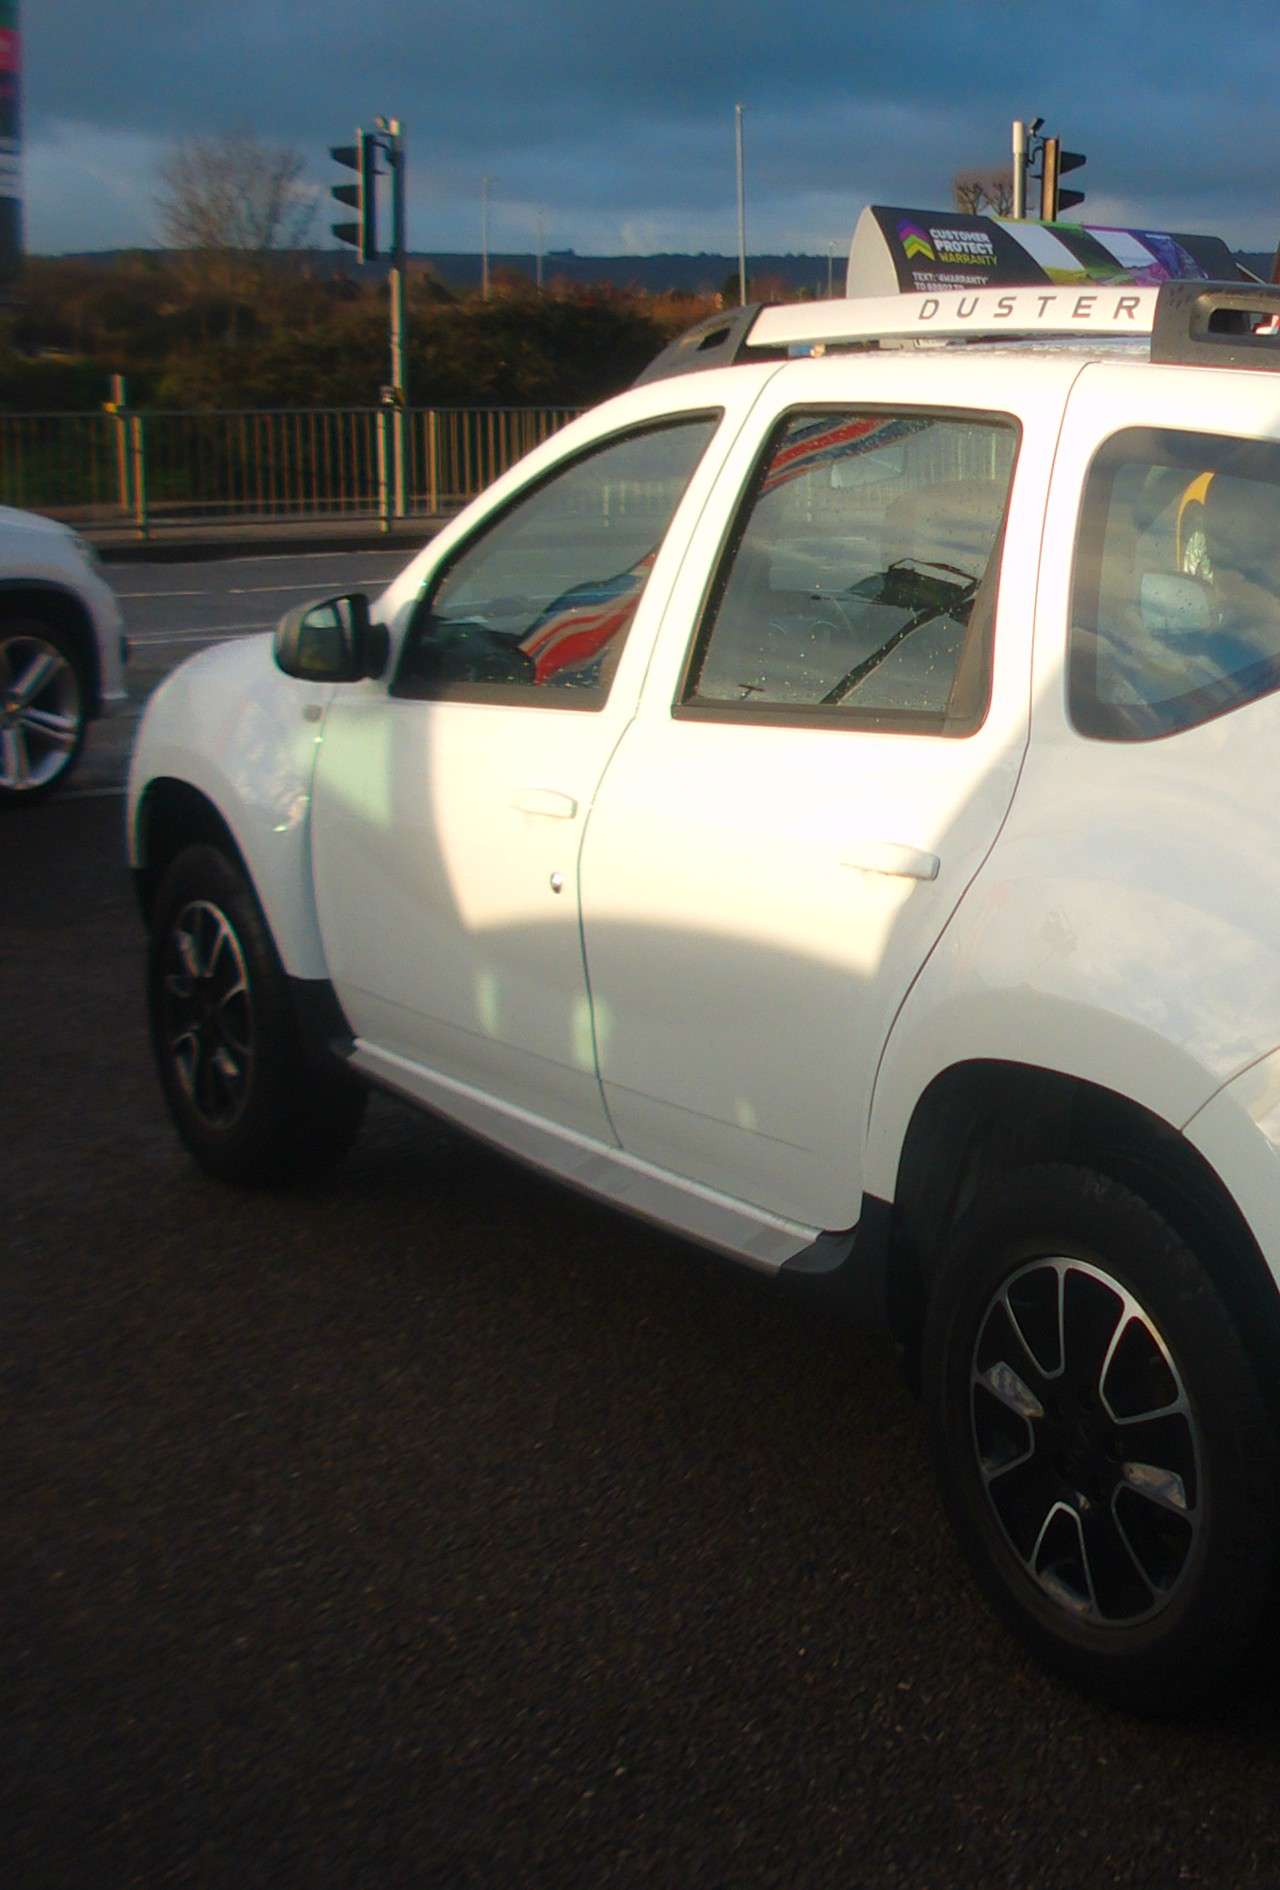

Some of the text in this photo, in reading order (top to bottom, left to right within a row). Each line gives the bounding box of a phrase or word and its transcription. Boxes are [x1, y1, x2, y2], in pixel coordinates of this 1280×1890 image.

[929, 228, 990, 243] CUSTOMER
[933, 239, 994, 255] PROTECT
[938, 252, 998, 265] WARRANTY
[918, 296, 1140, 320] DUSTER
